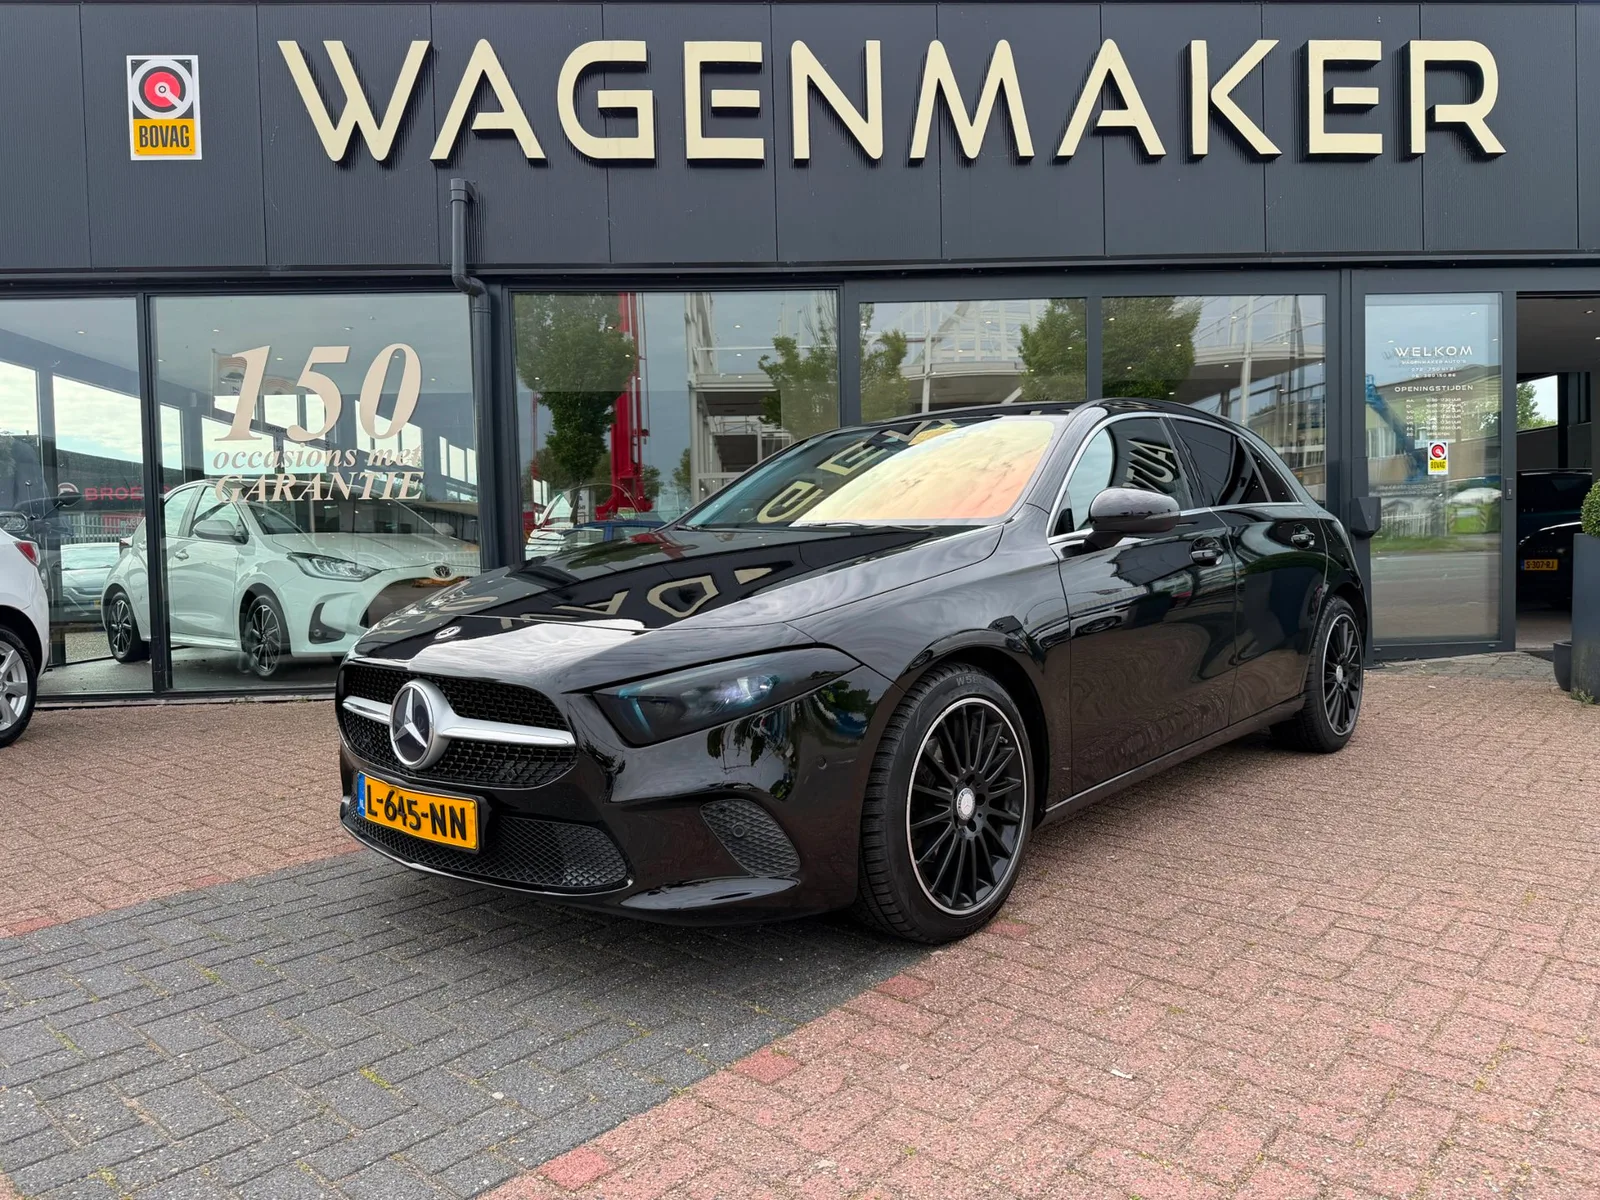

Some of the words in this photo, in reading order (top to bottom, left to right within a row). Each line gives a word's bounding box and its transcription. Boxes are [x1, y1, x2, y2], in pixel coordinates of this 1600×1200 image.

[277, 38, 1507, 162] WAGENMAKER
[138, 123, 191, 149] BOVAG
[1394, 345, 1473, 357] WELKOM
[214, 342, 423, 441] 150
[1394, 384, 1474, 393] OPENINGSTIJDEN
[212, 443, 358, 470] occasions
[367, 447, 424, 469] met
[84, 486, 144, 501] BROE
[214, 471, 425, 504] GARANTIE
[365, 784, 468, 841] L-645-NN
